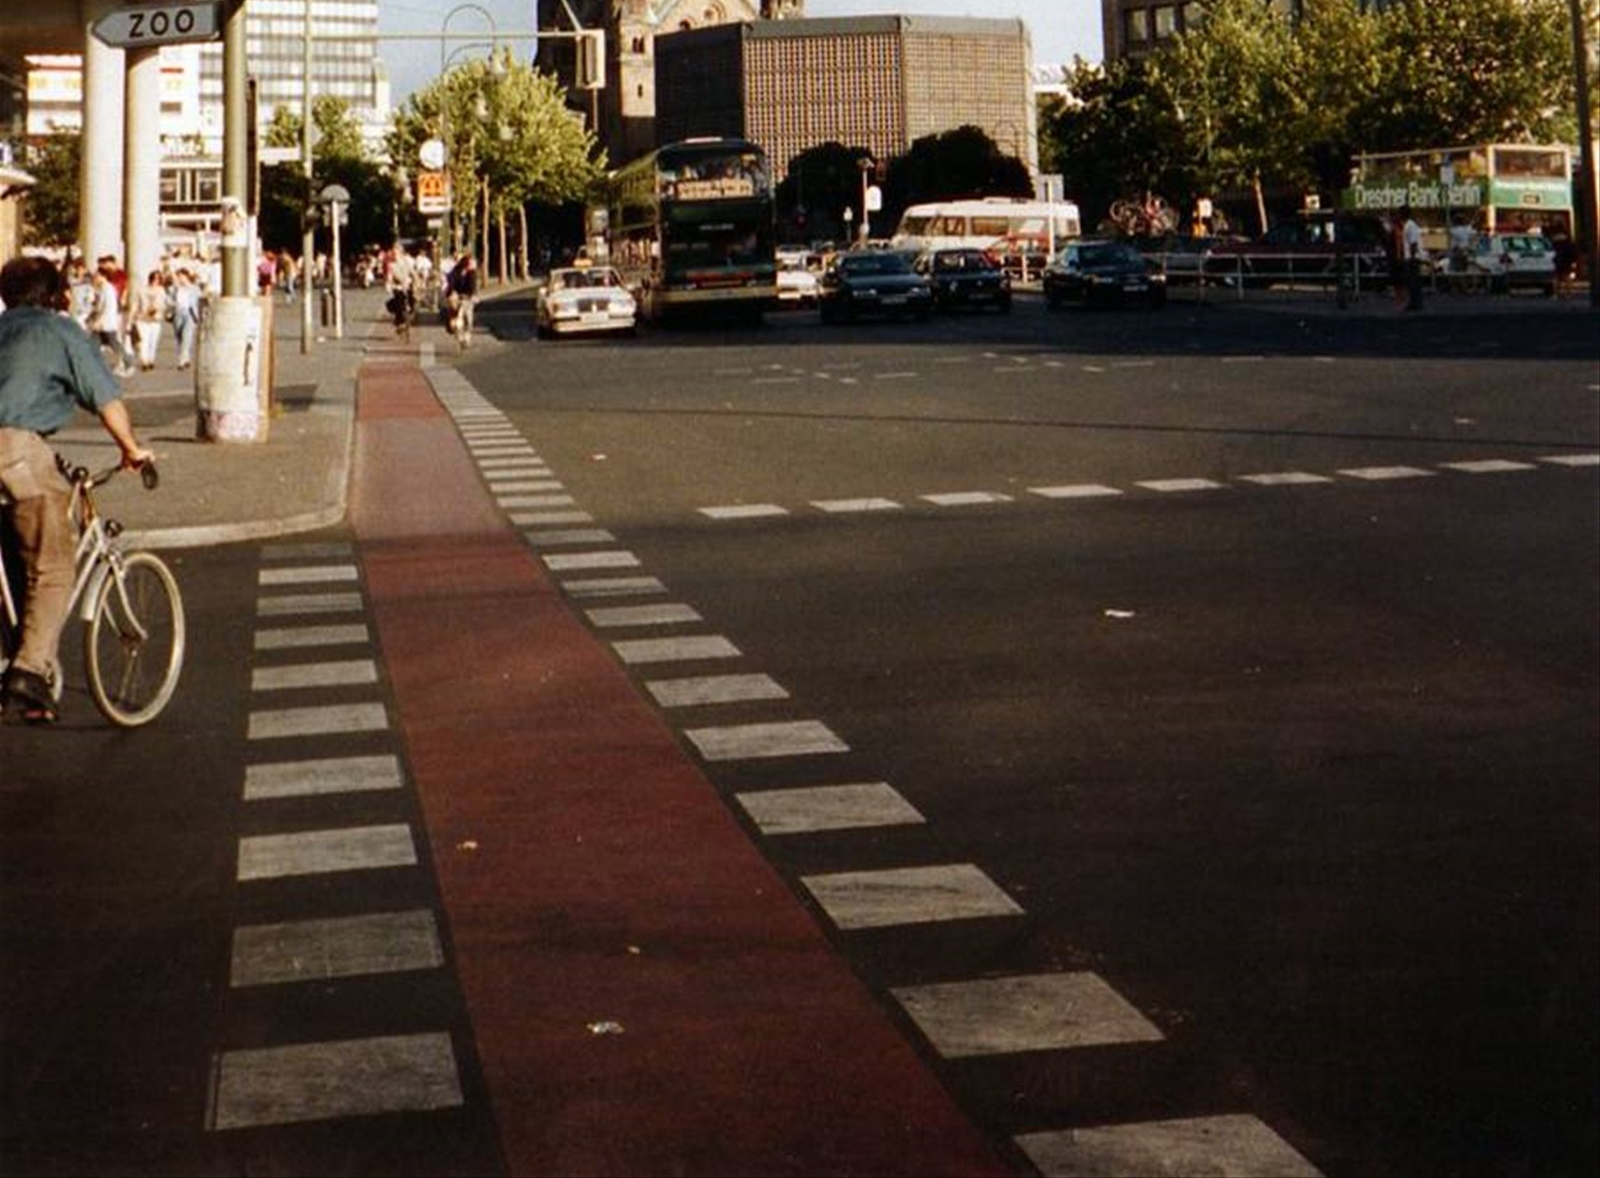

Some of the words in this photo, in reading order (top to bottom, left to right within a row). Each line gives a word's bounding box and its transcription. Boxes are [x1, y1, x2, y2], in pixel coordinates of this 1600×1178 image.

[128, 9, 195, 38] ZOO
[1354, 183, 1407, 209] Dresdner
[1408, 181, 1440, 208] Bank
